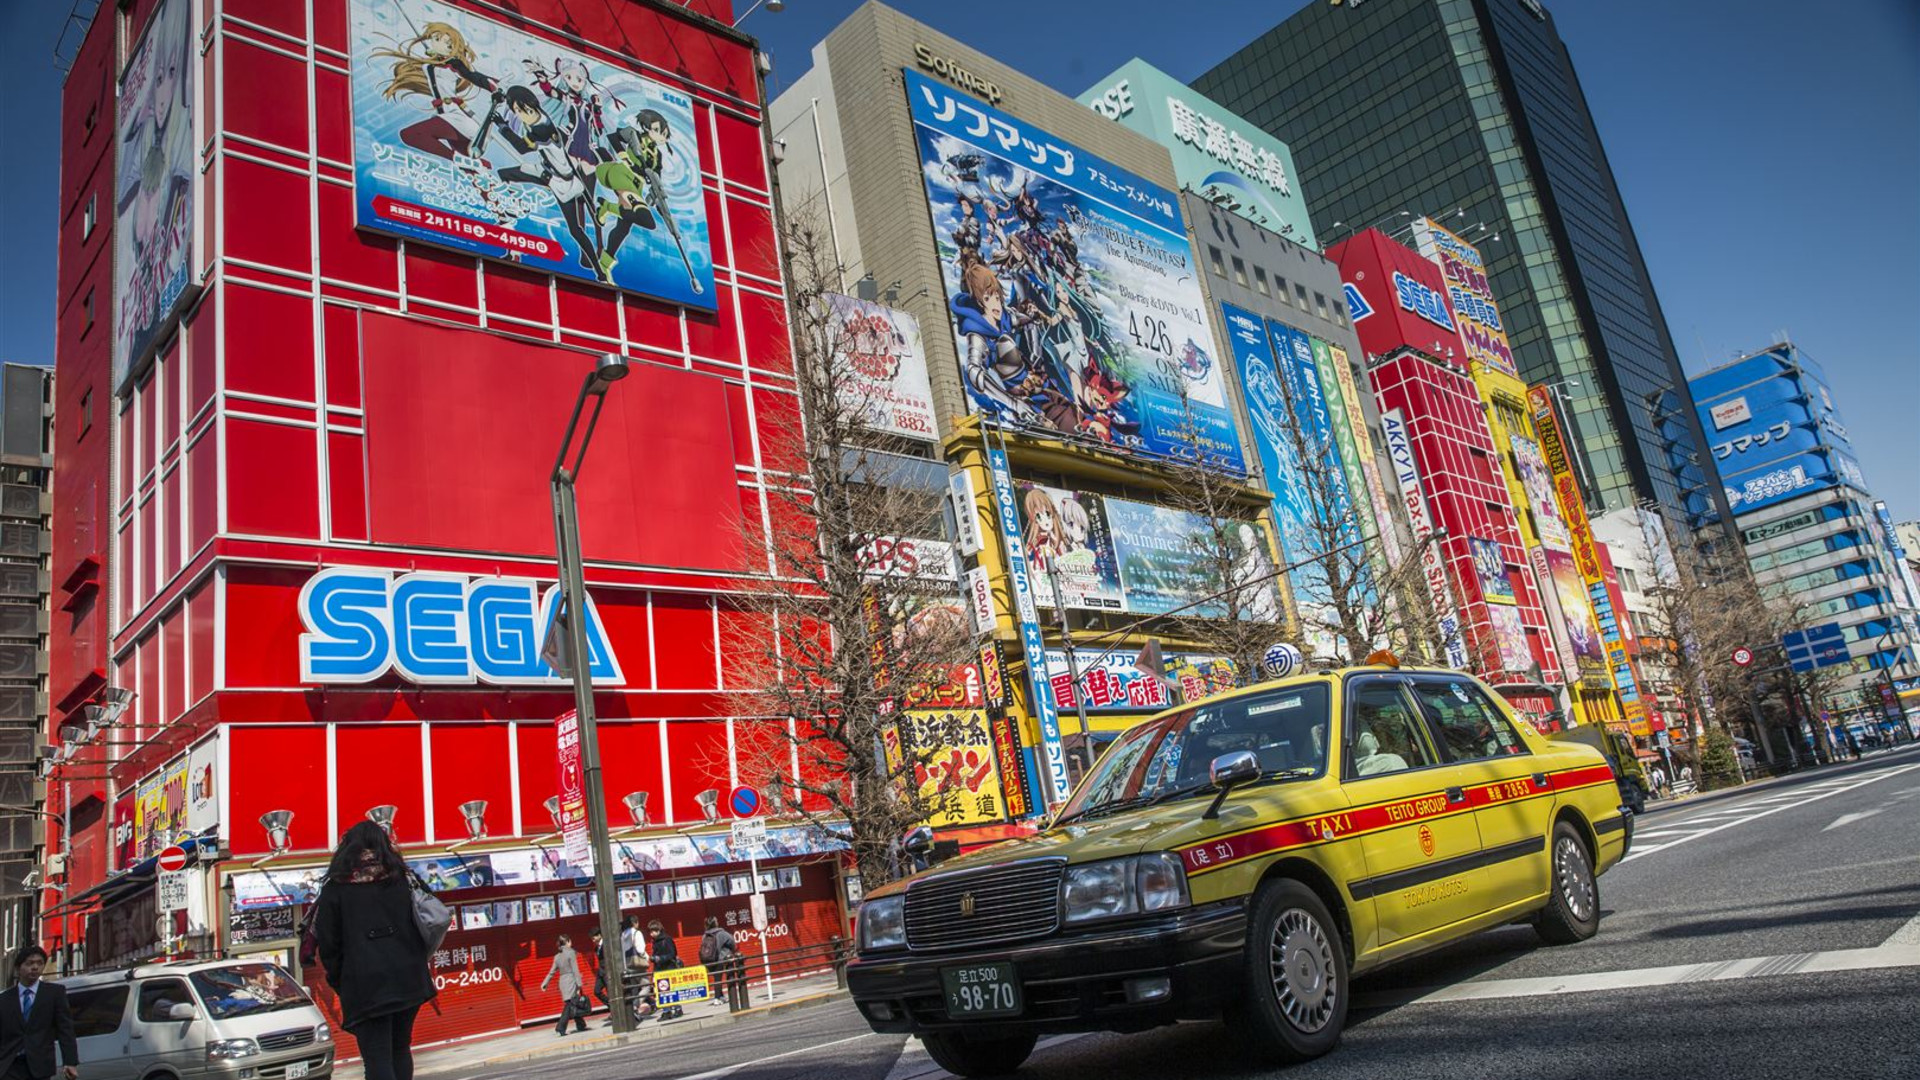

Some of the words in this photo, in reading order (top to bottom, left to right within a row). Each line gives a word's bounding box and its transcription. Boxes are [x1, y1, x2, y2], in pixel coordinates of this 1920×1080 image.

[915, 42, 1001, 102] Sofmap
[920, 84, 1075, 177] ソフマップ
[1086, 166, 1174, 219] アミューズメント館
[1392, 271, 1456, 334] SEGA
[1129, 309, 1173, 357] 4.26
[1156, 357, 1178, 378] ON
[1384, 417, 1412, 473] AKKY
[1710, 420, 1792, 460] フマップ
[994, 469, 1017, 532] 売るのも
[1120, 524, 1180, 553] Summer
[1404, 484, 1435, 567] Tax-fee
[1533, 549, 1550, 579] GAME
[974, 580, 990, 619] GPS
[1011, 556, 1034, 622] 買うのも
[299, 567, 626, 685] SEGA
[983, 649, 1001, 698] ラーメン
[1735, 651, 1749, 663] 50
[964, 667, 980, 704] 2F
[1027, 646, 1056, 739] サポートも
[879, 702, 894, 716] 2F
[1385, 801, 1416, 822] TEITO
[1416, 797, 1447, 816] GROUP
[1487, 786, 1503, 801] 無線
[1505, 781, 1530, 799] 2853
[116, 820, 133, 847] BIG
[1307, 813, 1352, 838] TAXI
[1404, 887, 1438, 909] TOKYO
[1438, 879, 1469, 900] KOTSU
[725, 905, 777, 926] 営業間
[427, 944, 487, 968] 業時間
[952, 993, 959, 1007] う
[960, 982, 1015, 1011] 98-70
